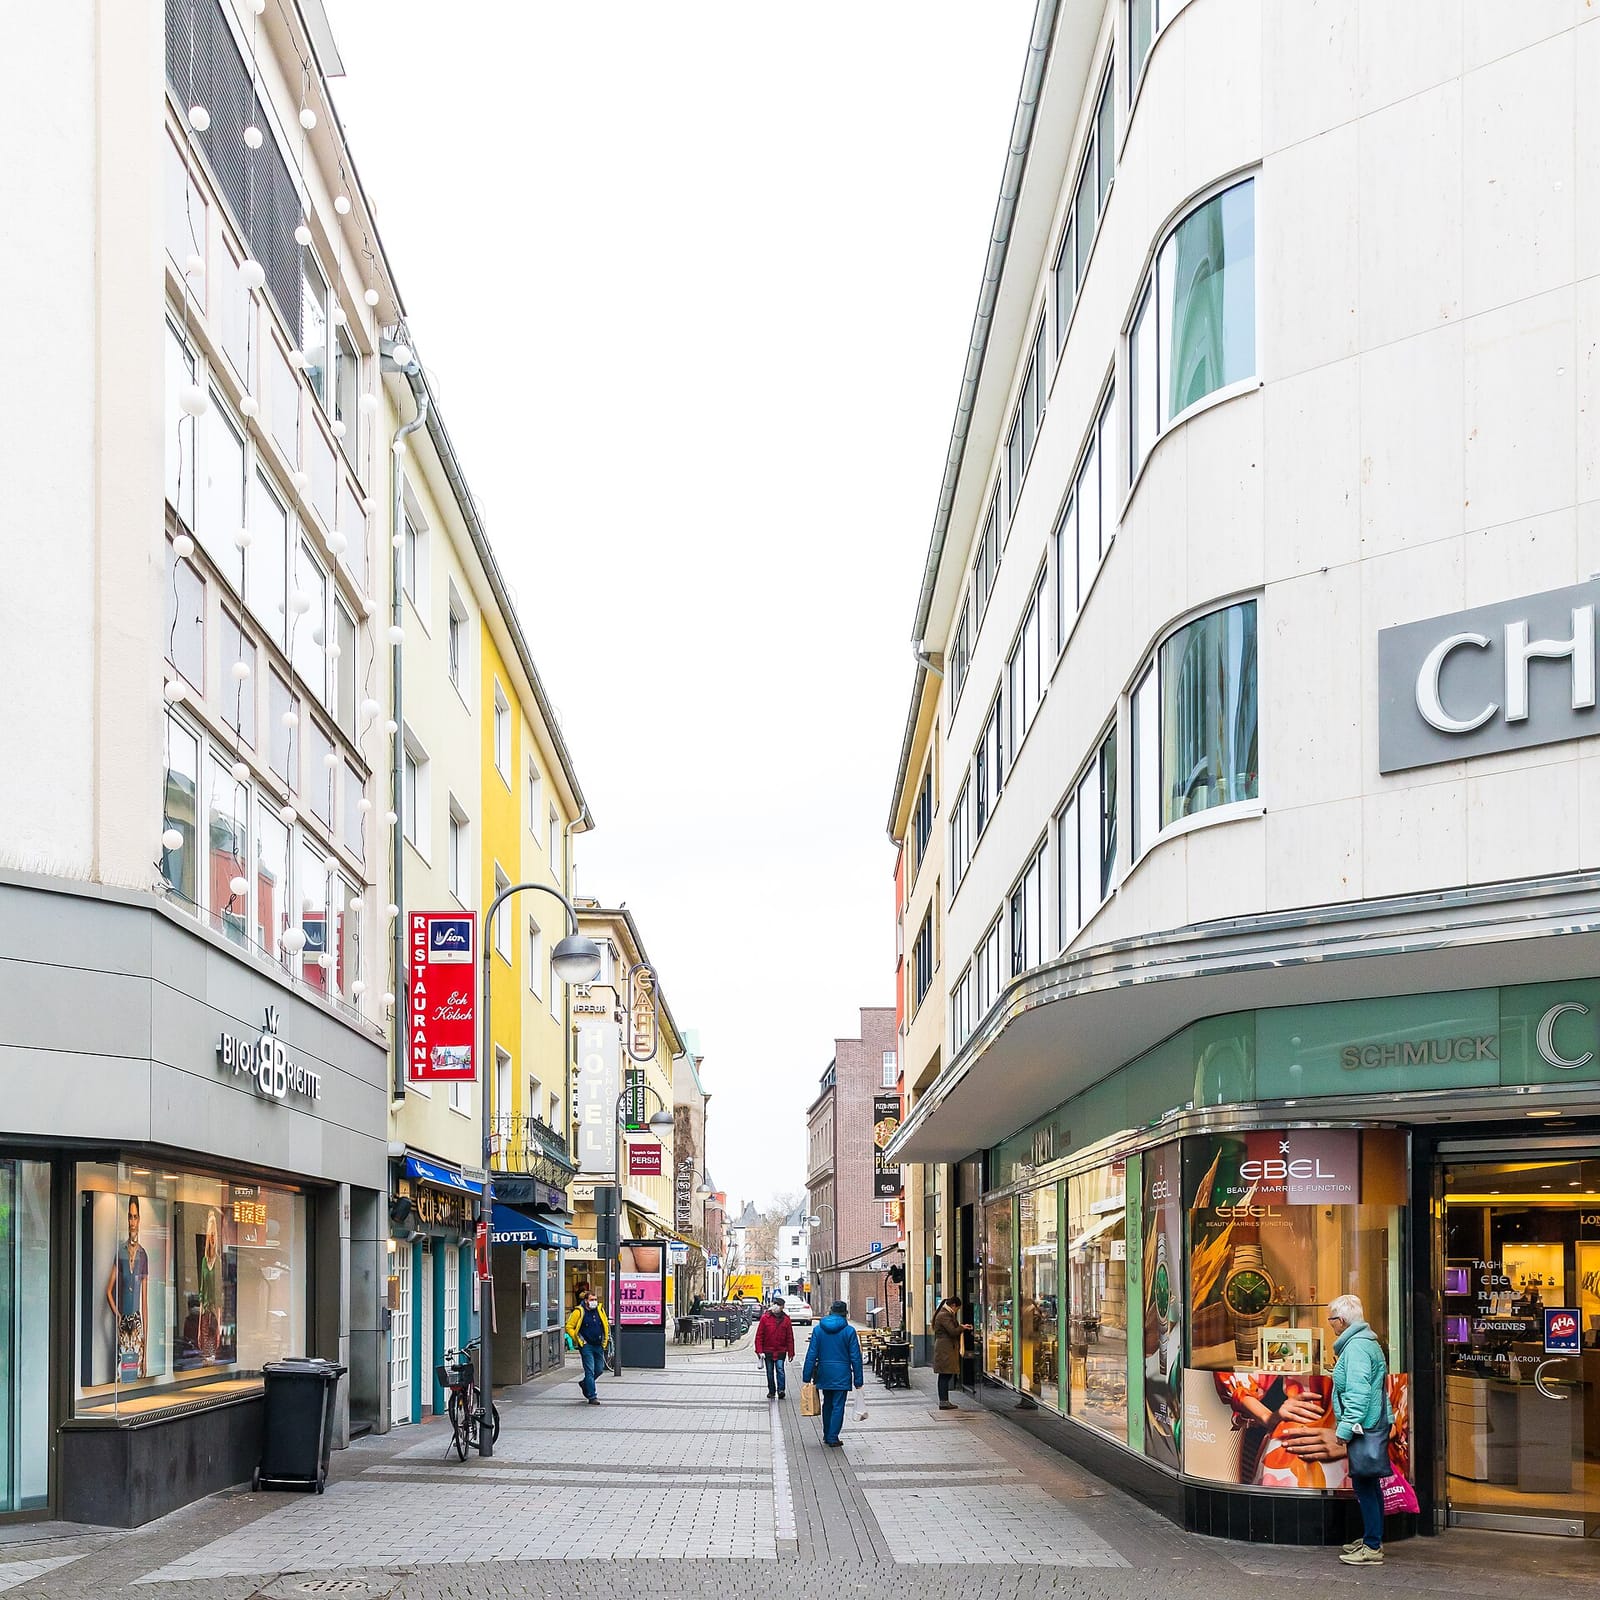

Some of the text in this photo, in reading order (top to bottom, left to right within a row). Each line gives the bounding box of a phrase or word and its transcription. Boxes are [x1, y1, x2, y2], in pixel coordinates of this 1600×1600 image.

[434, 927, 466, 946] Sion
[413, 916, 427, 1076] RESTAURANT
[632, 969, 654, 1052] CAFE
[220, 1032, 260, 1076] BIJOU
[1341, 1036, 1498, 1070] SCHMUCK
[584, 1028, 604, 1151] HOTEL
[631, 1156, 660, 1164] PERSIA
[1240, 1158, 1335, 1180] EBEL
[1226, 1184, 1351, 1194] BEAUTY MARRIES FUNCTION
[1215, 1205, 1281, 1218] EBEL
[491, 1231, 537, 1242] HOTEL
[1480, 1275, 1510, 1285] EBE
[620, 1288, 645, 1300] HEJ
[1473, 1322, 1527, 1331] LONGINES
[1551, 1316, 1575, 1332] AHA
[1459, 1353, 1492, 1361] MAURICE
